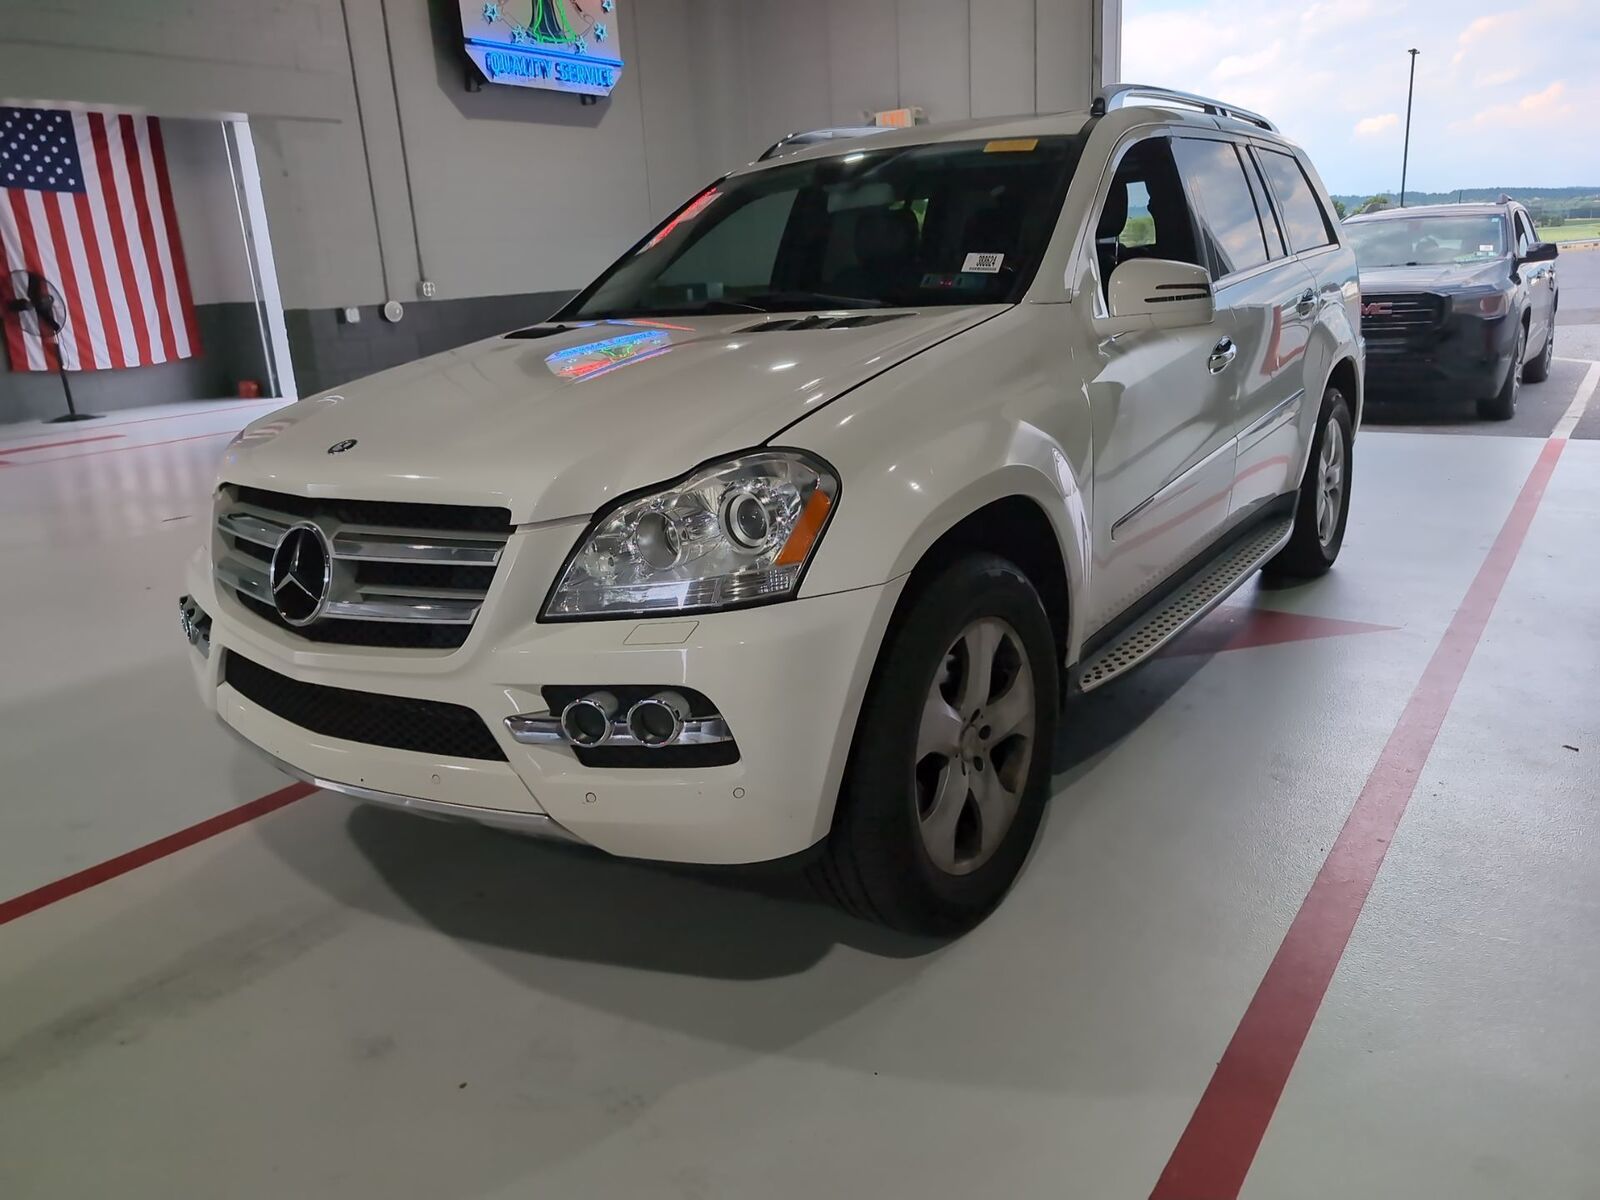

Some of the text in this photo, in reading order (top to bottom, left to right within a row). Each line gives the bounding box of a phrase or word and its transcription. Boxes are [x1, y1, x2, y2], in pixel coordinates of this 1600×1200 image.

[485, 51, 614, 87] QUALITY SERVICE
[1361, 301, 1393, 315] MC
